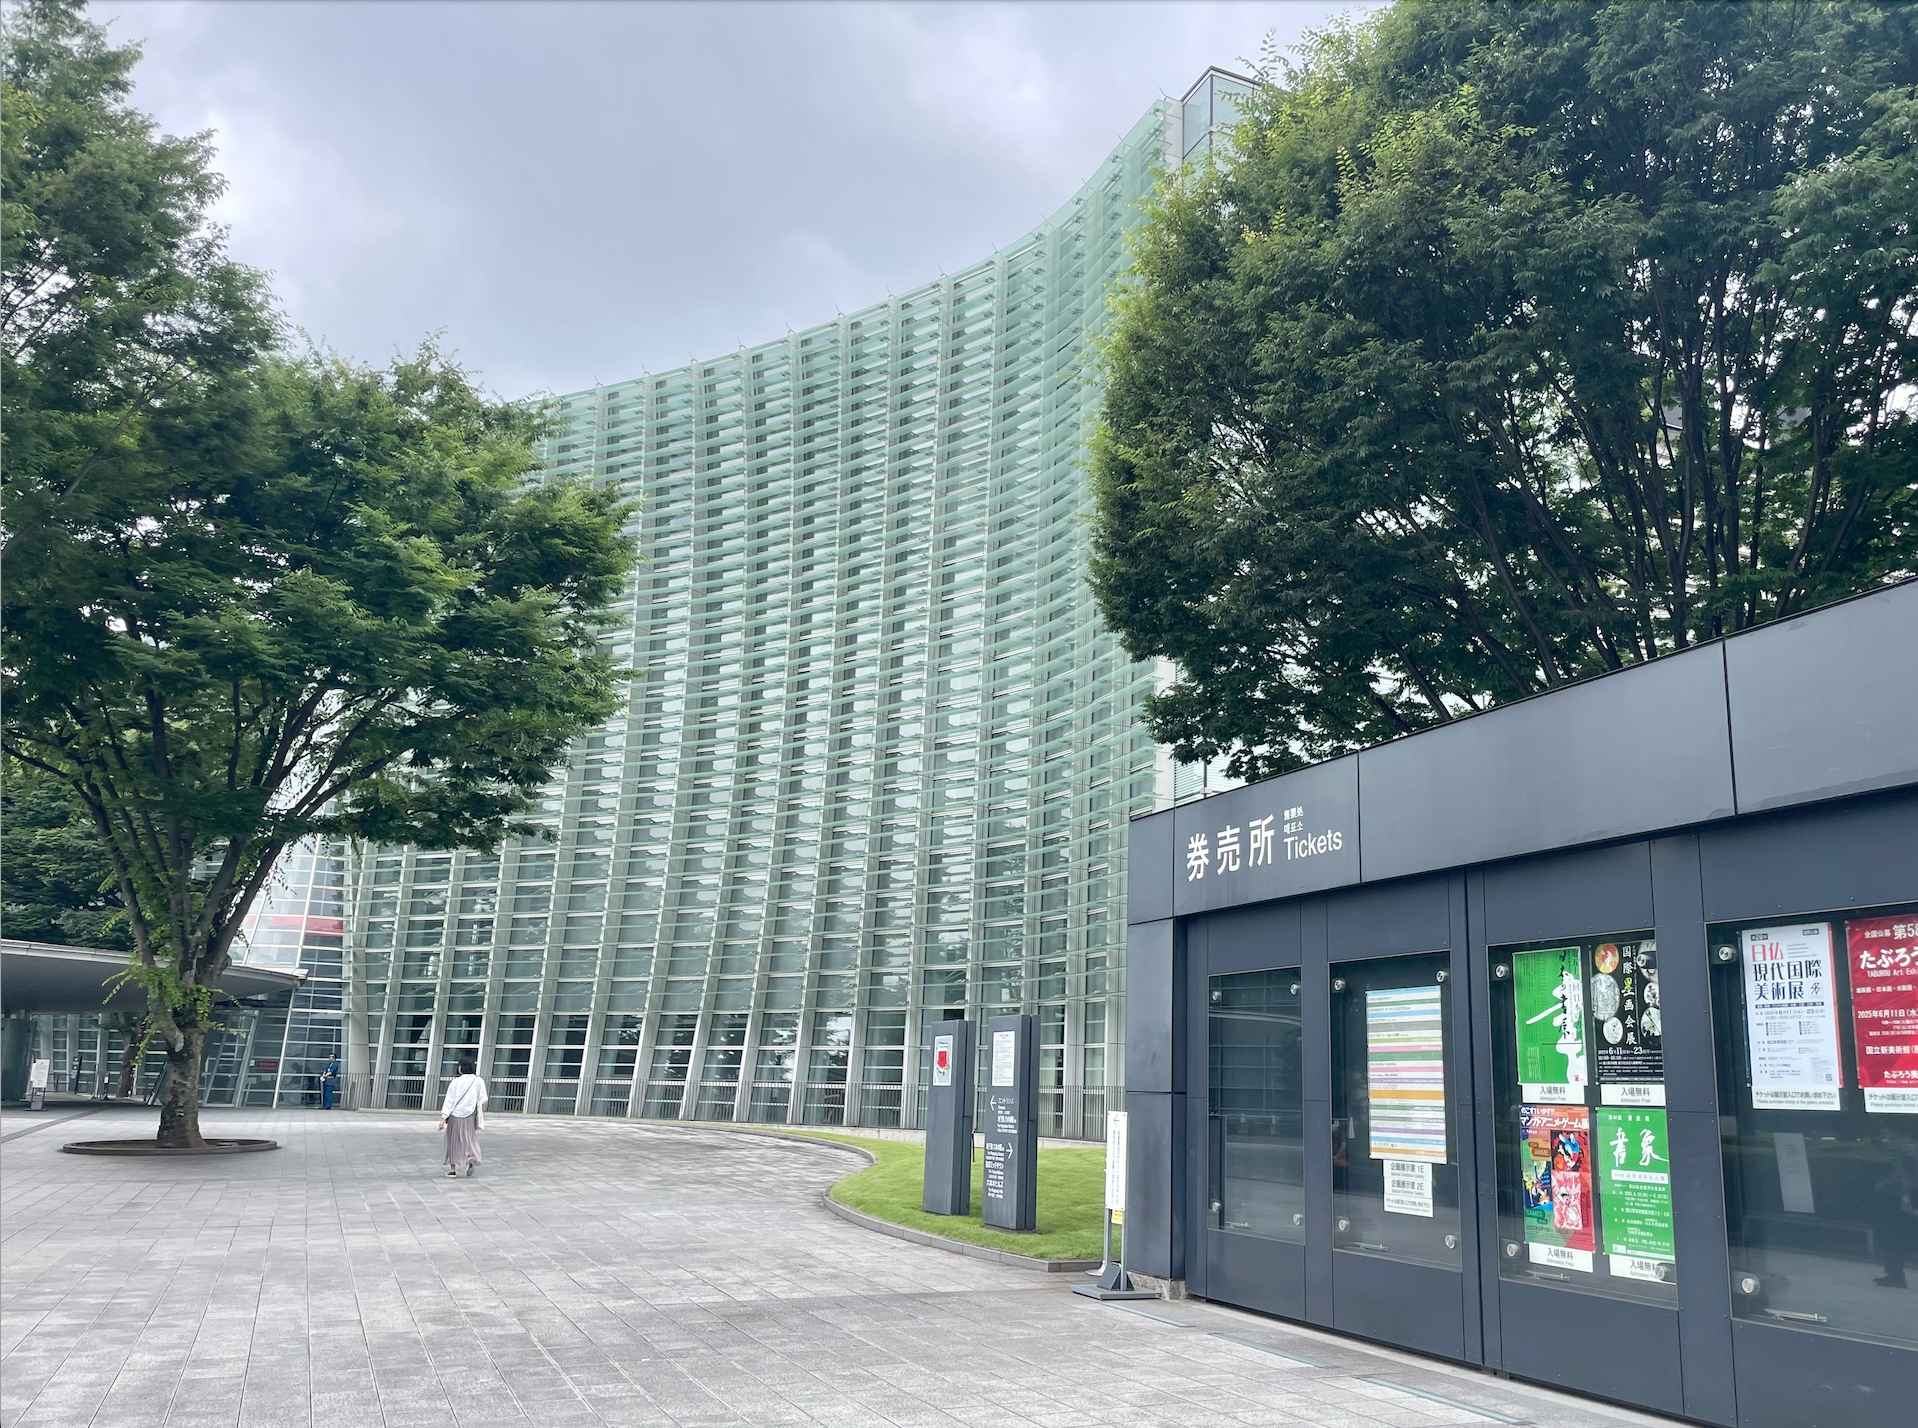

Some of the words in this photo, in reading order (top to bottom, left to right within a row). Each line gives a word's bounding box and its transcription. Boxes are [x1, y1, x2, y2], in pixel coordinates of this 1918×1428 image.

[1283, 820, 1304, 835] 매표소
[1186, 813, 1275, 882] 券売所
[1283, 829, 1343, 861] Tickets
[1751, 942, 1784, 962] 日仏
[1753, 959, 1822, 982] 現代国際
[1621, 945, 1638, 1045] 国際墨画会展
[1754, 980, 1805, 1001] 美術展
[1540, 1086, 1566, 1095] 入場無料
[1621, 1087, 1650, 1097] 入場無料
[1547, 1248, 1573, 1260] 入場無料
